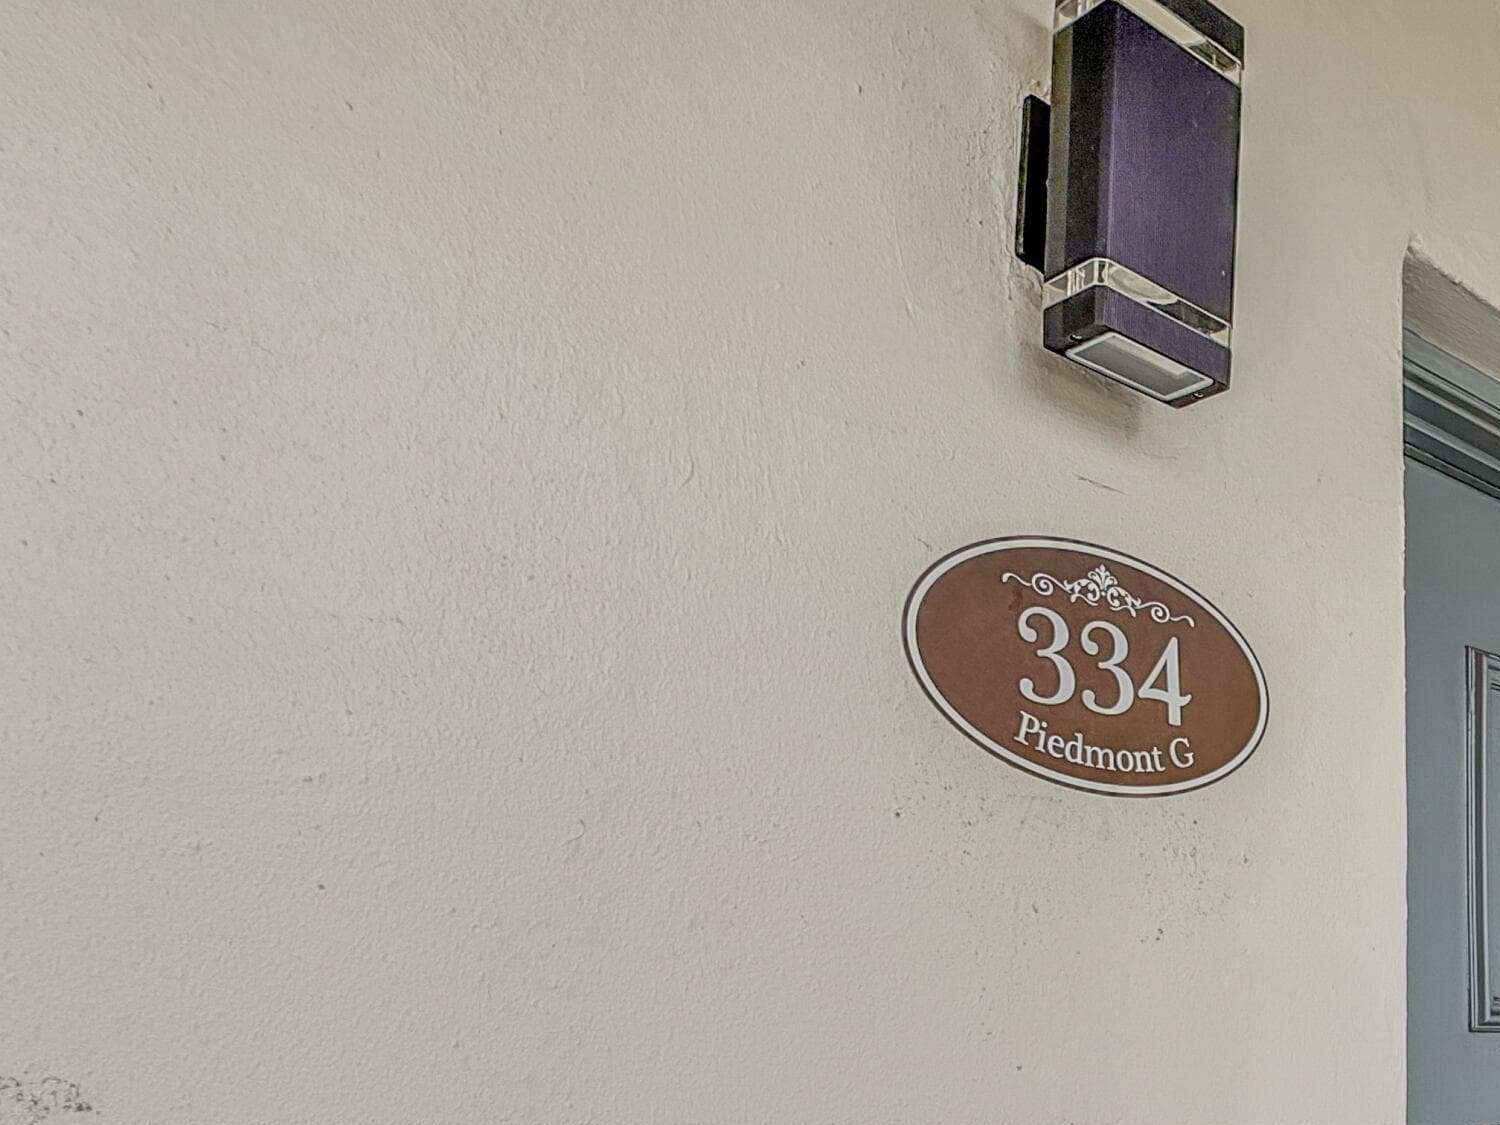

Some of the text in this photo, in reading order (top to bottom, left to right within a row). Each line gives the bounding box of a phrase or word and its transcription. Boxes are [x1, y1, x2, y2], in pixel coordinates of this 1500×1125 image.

[1017, 606, 1192, 726] 334
[1013, 710, 1195, 773] Piedmont G
